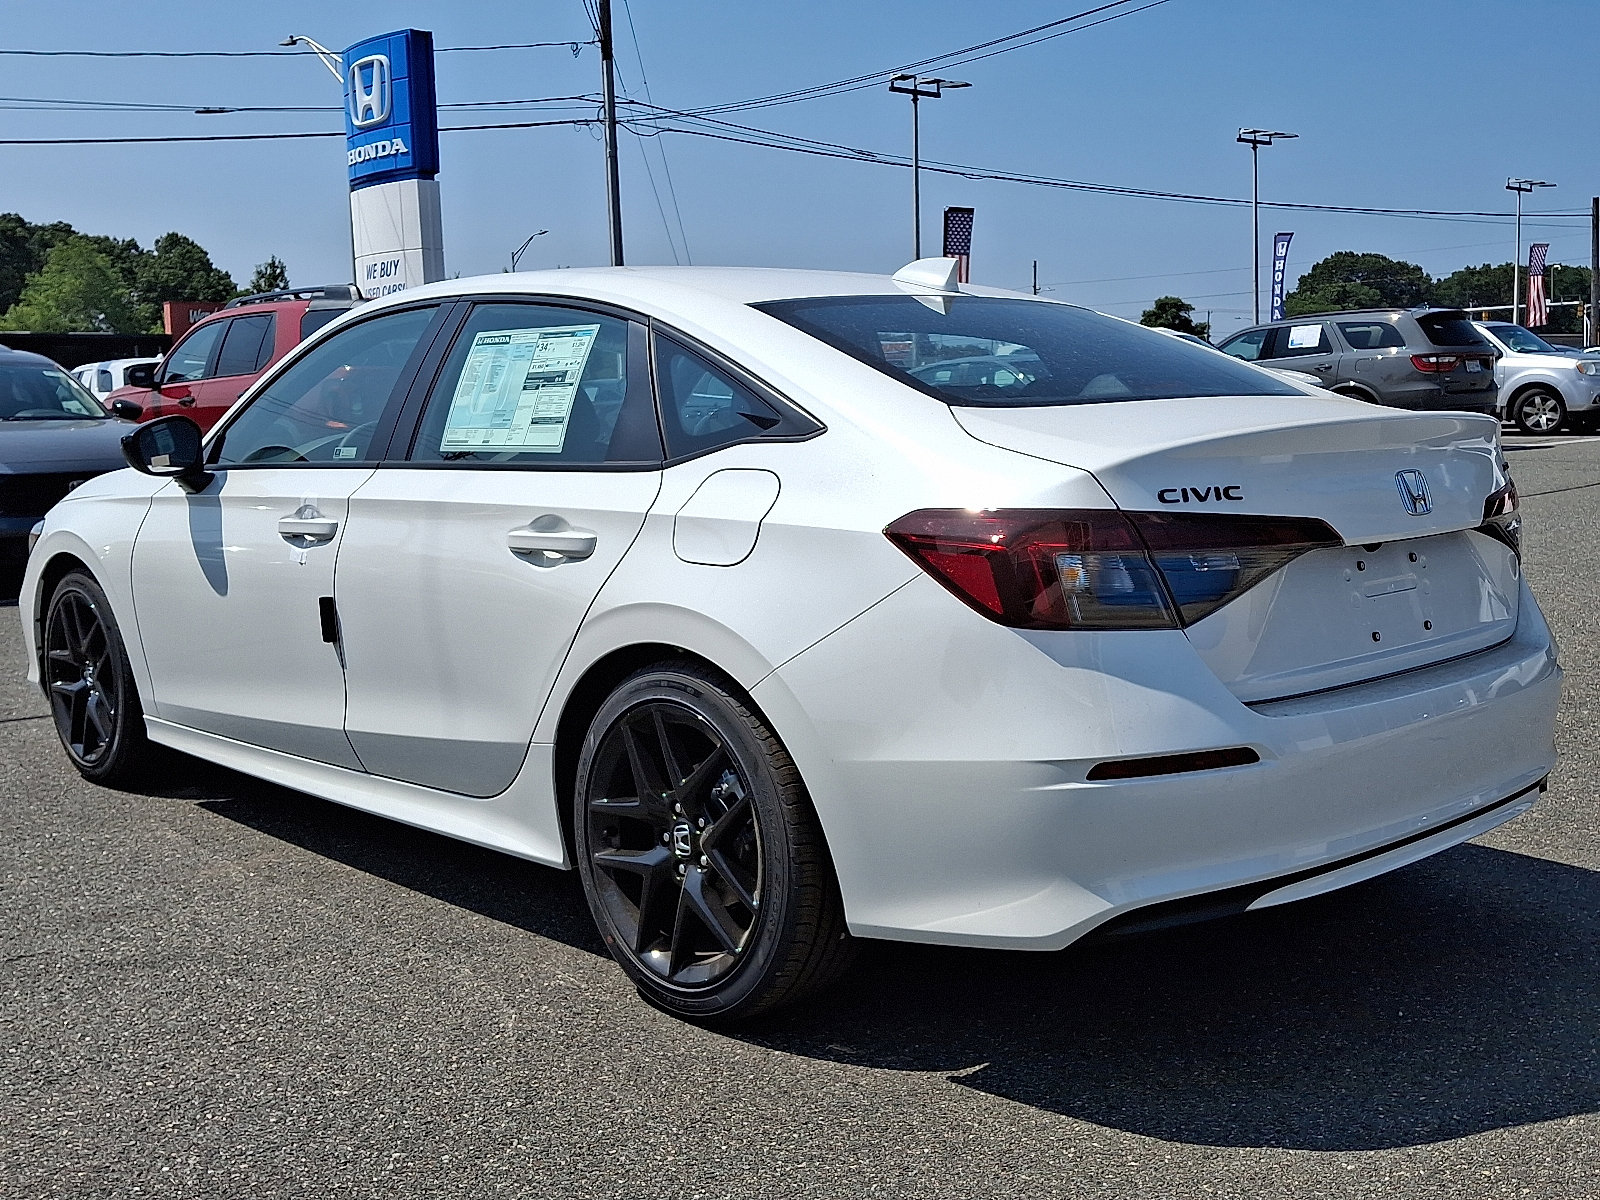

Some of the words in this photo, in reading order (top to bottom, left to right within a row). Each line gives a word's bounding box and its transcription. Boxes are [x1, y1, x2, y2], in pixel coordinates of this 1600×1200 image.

[347, 138, 409, 166] HONDA
[366, 263, 378, 281] WE
[379, 259, 400, 278] BUY
[1273, 260, 1285, 320] HONDA
[483, 336, 510, 344] HONDA
[1157, 485, 1244, 504] CIVIC
